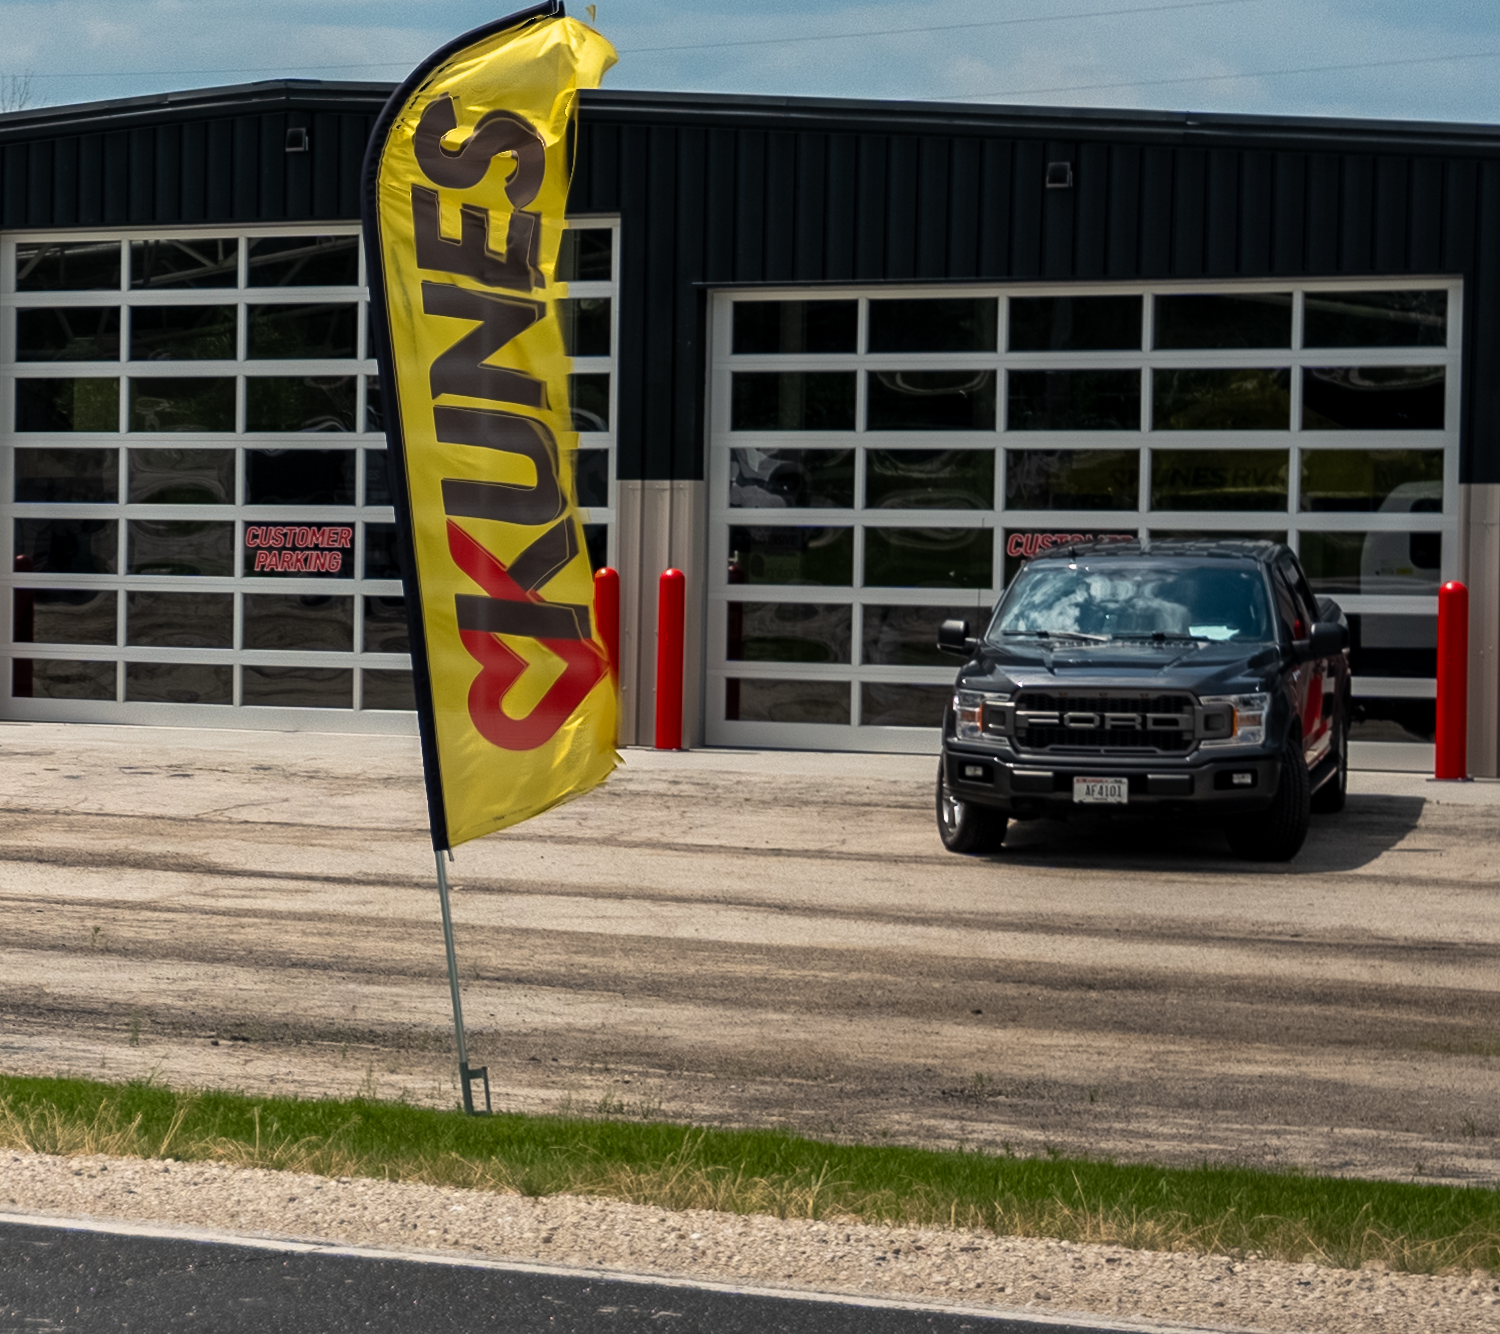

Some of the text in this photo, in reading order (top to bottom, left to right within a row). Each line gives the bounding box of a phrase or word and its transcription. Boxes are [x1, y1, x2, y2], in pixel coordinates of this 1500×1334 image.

[410, 91, 593, 643] KUNES
[245, 525, 352, 548] CUSTOMER
[254, 550, 342, 573] PARKING
[1016, 711, 1188, 730] FORD
